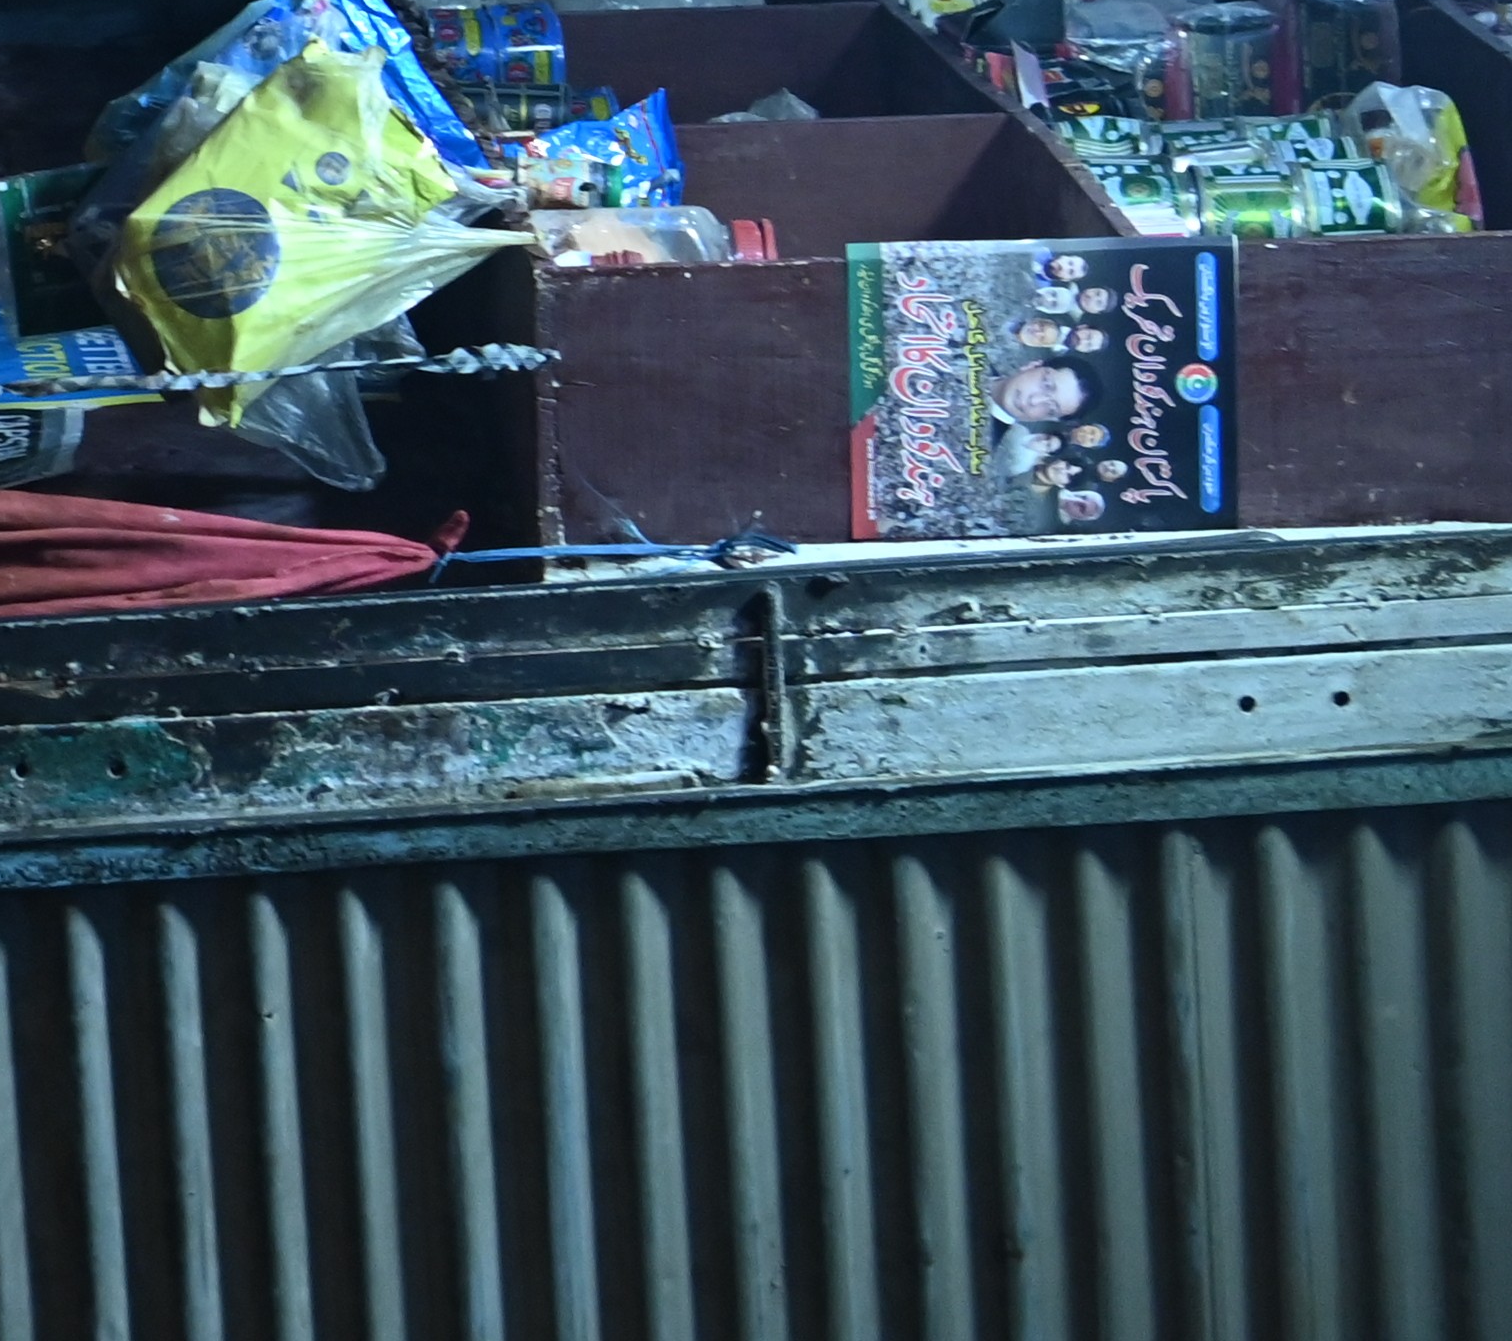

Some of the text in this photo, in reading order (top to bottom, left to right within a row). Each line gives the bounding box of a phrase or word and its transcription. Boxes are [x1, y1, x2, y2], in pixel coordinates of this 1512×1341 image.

[894, 271, 958, 347] اتحاد
[1119, 263, 1184, 343] تحریک
[1120, 427, 1189, 505] پاکستان
